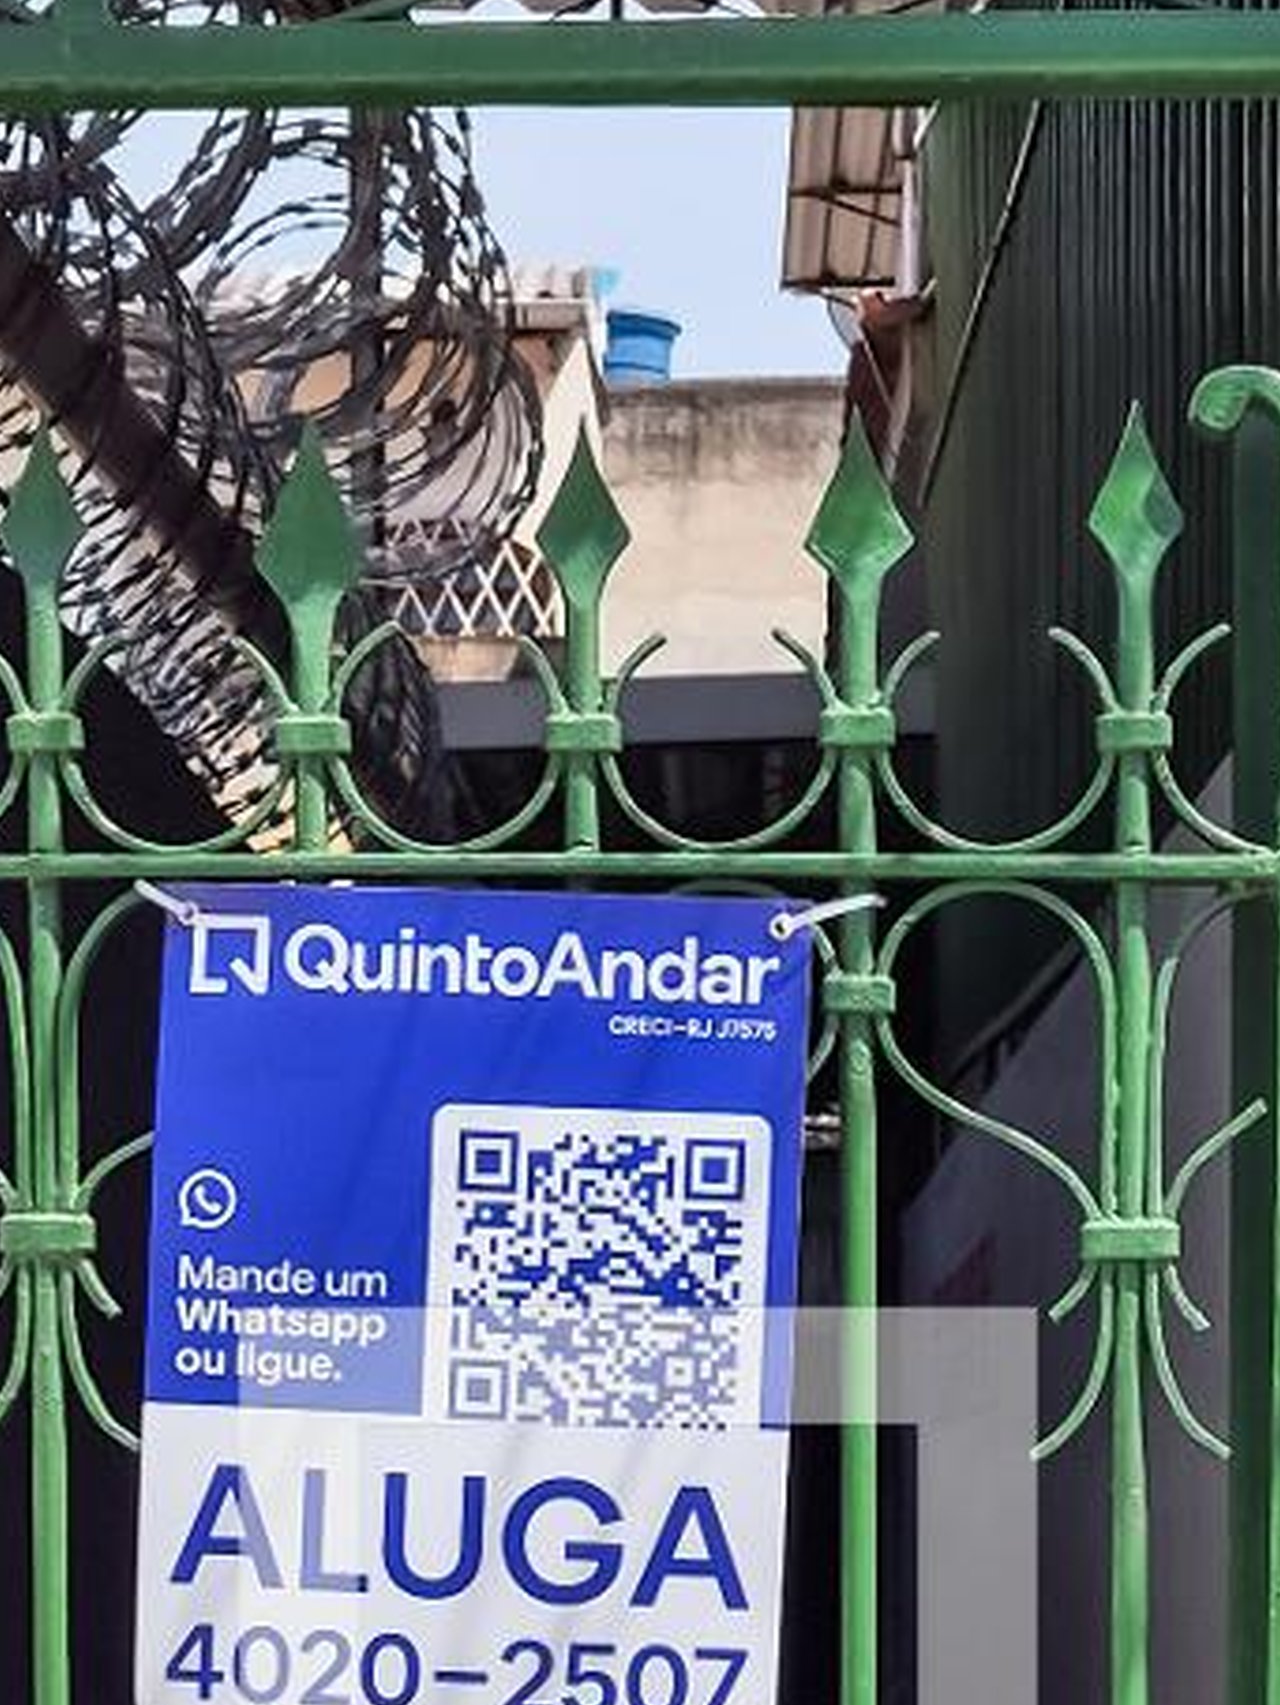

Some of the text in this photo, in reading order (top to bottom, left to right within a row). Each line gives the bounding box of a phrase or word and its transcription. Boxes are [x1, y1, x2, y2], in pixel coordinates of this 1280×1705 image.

[283, 922, 780, 1006] QuintoAndar
[178, 1254, 387, 1298] Mande um
[175, 1296, 387, 1347] Whatsapp
[174, 1342, 342, 1386] ou ligue.
[168, 1463, 750, 1612] ALUGA
